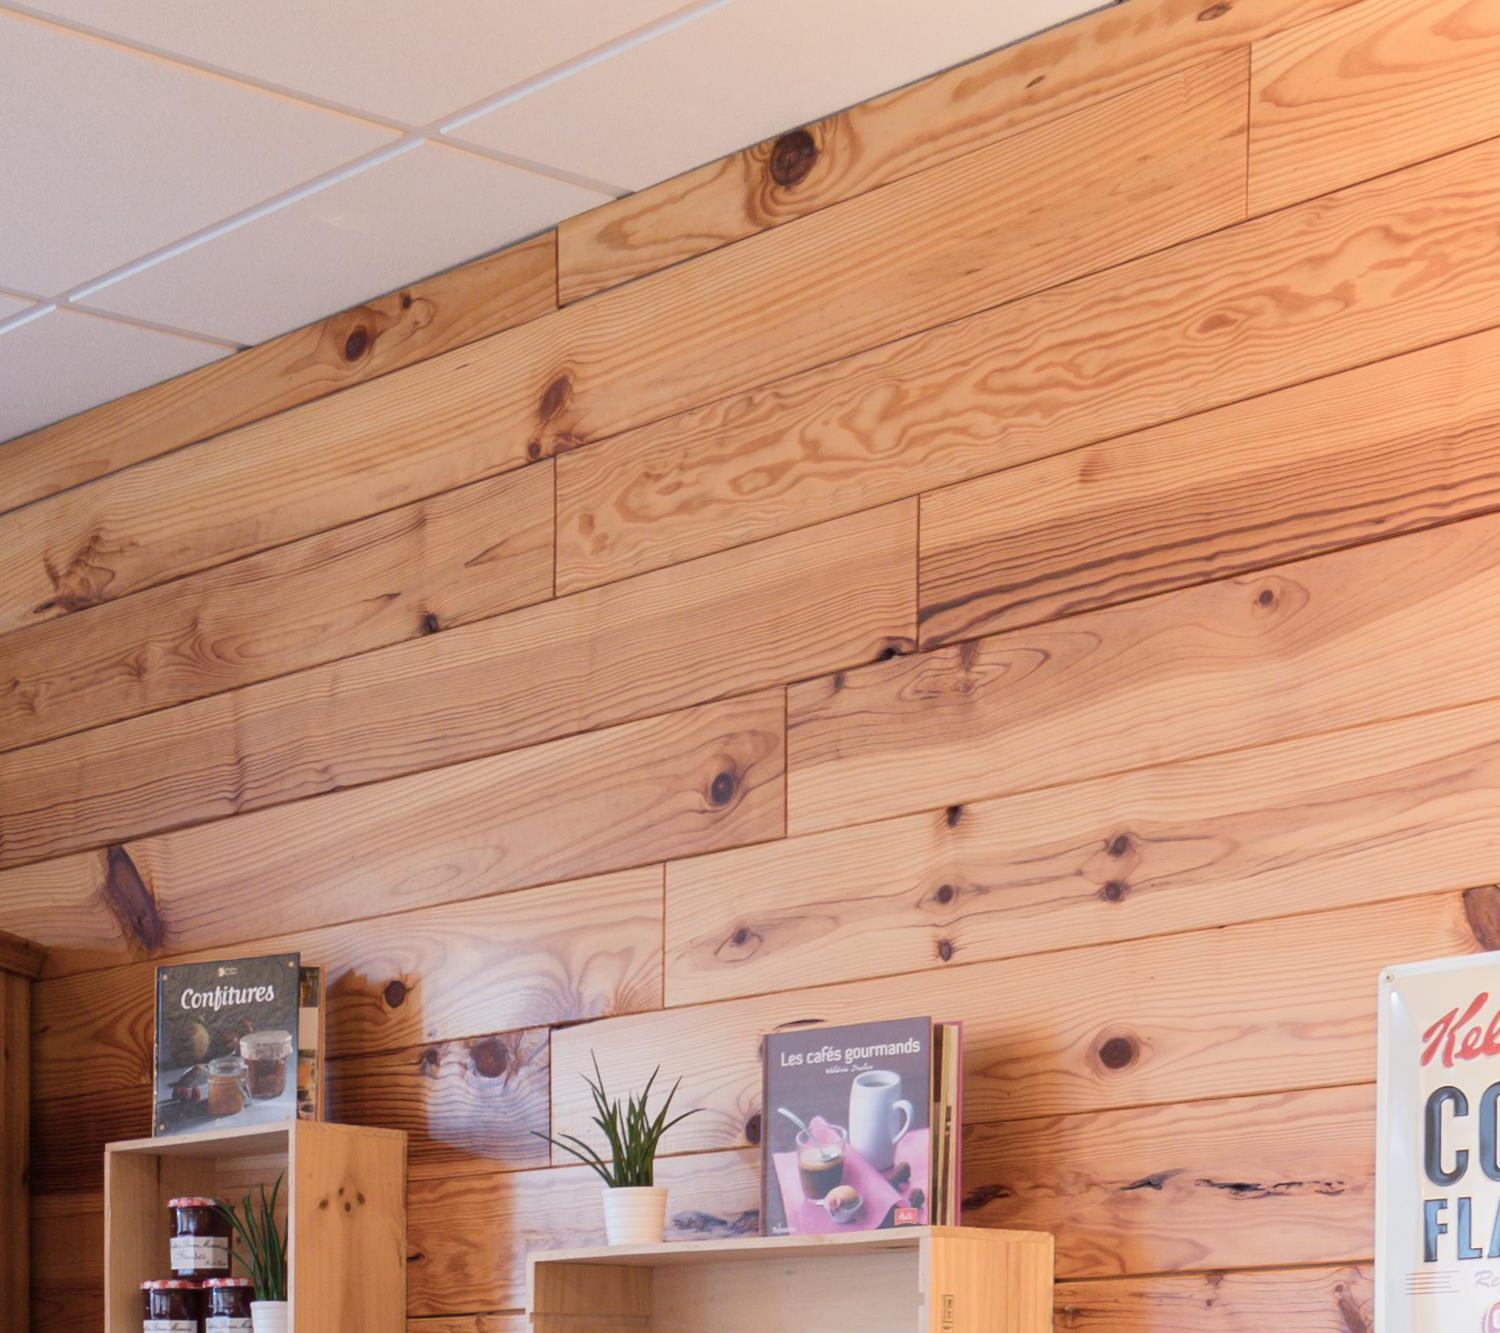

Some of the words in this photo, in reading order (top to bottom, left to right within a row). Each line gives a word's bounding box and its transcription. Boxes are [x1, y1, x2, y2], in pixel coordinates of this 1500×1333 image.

[181, 984, 275, 1012] Confitures
[780, 1052, 803, 1067] Les
[806, 1046, 842, 1064] cafés
[845, 1037, 921, 1065] gourmands
